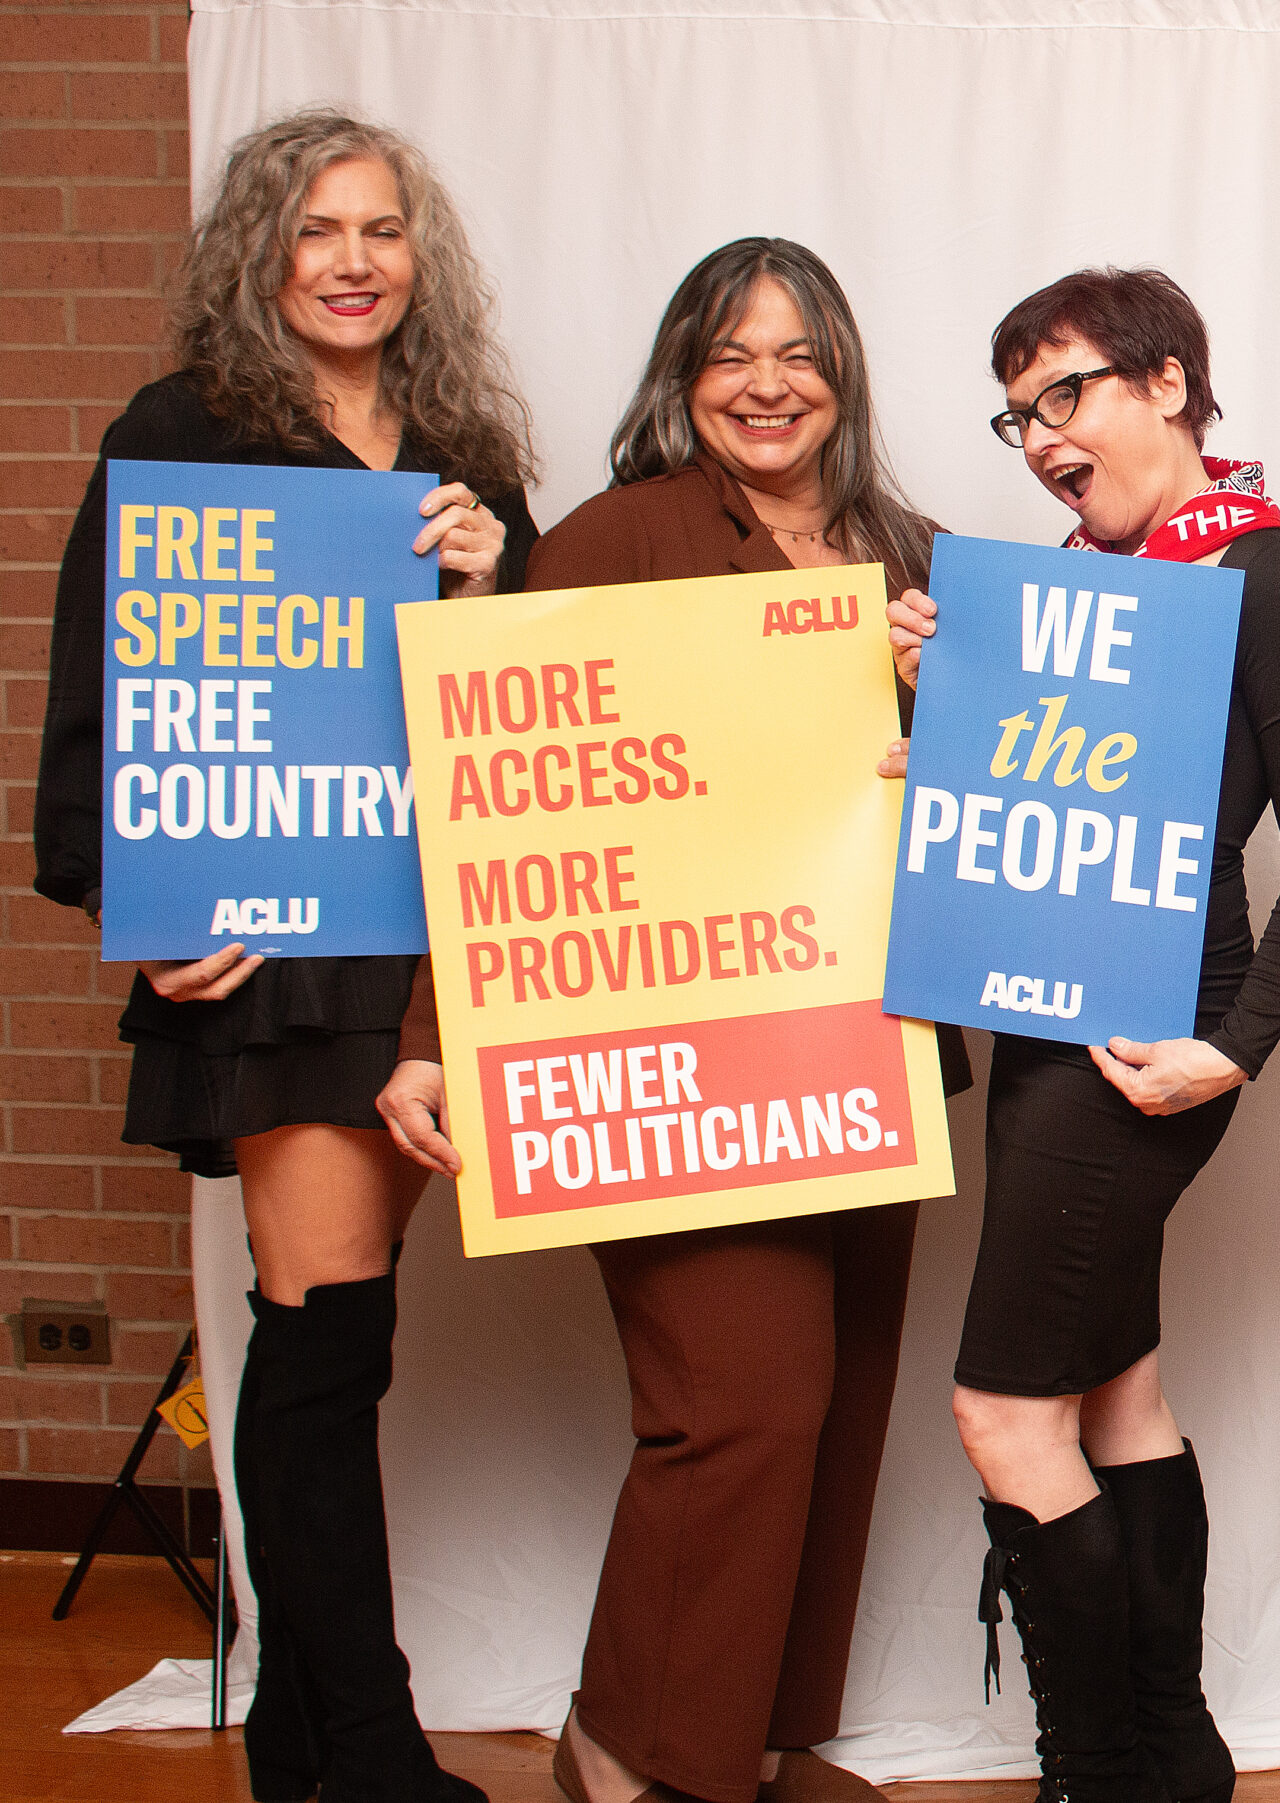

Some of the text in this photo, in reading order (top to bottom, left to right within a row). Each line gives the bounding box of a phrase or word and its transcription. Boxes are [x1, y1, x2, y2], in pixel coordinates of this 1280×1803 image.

[119, 504, 275, 582] FREE
[1167, 504, 1256, 541] THE
[114, 590, 365, 670] SPEECH
[762, 595, 859, 637] ACLU
[1022, 582, 1138, 685] WE
[116, 678, 273, 753] FREE
[438, 658, 620, 739] MORE
[448, 732, 708, 821] ACCESS.
[989, 694, 1138, 793] the
[113, 763, 416, 840] COUNTRY
[457, 845, 640, 929] MORE
[907, 785, 1205, 913] PEOPLE
[210, 898, 319, 936] ACLU
[466, 904, 839, 1008] PROVIDERS.
[980, 971, 1084, 1020] ACLU
[502, 1041, 703, 1124] FEWER
[511, 1087, 899, 1196] POLITICIANS.
